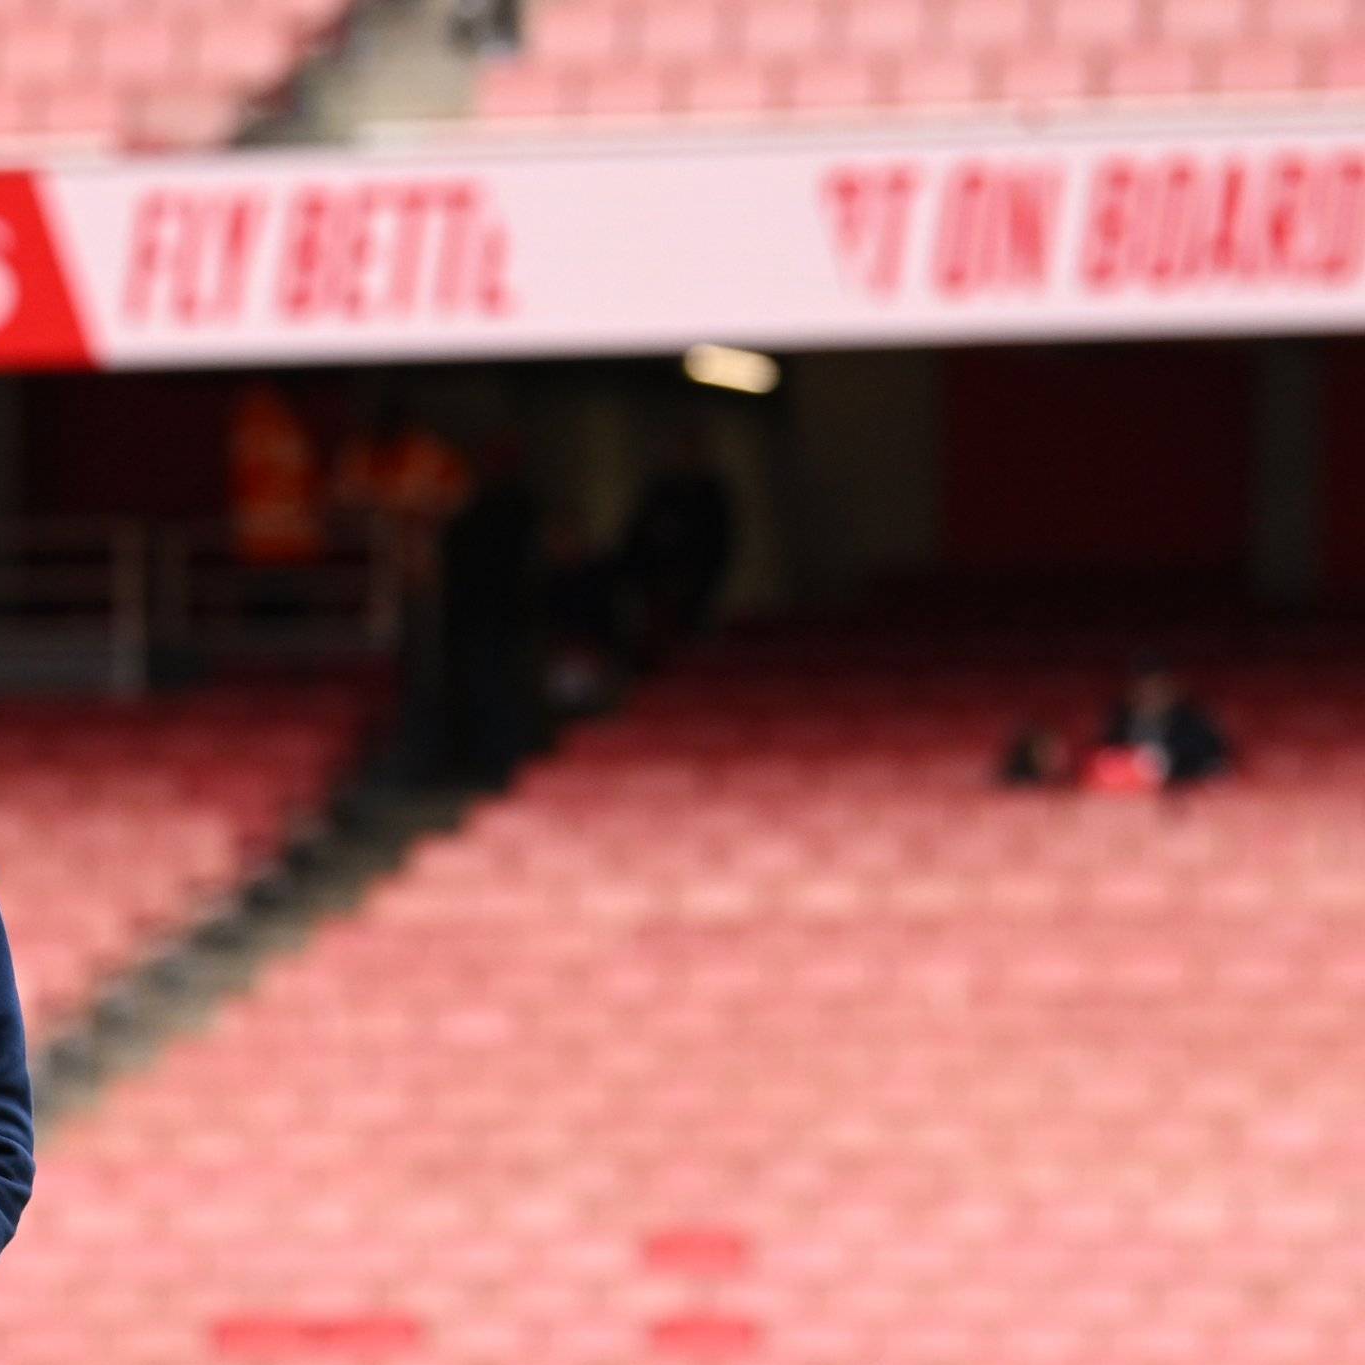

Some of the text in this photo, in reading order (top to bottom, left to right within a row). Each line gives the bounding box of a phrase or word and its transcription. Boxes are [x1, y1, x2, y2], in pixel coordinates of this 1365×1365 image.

[123, 184, 270, 323] FLY
[929, 160, 1065, 298] ON
[1081, 150, 1365, 290] BOARD
